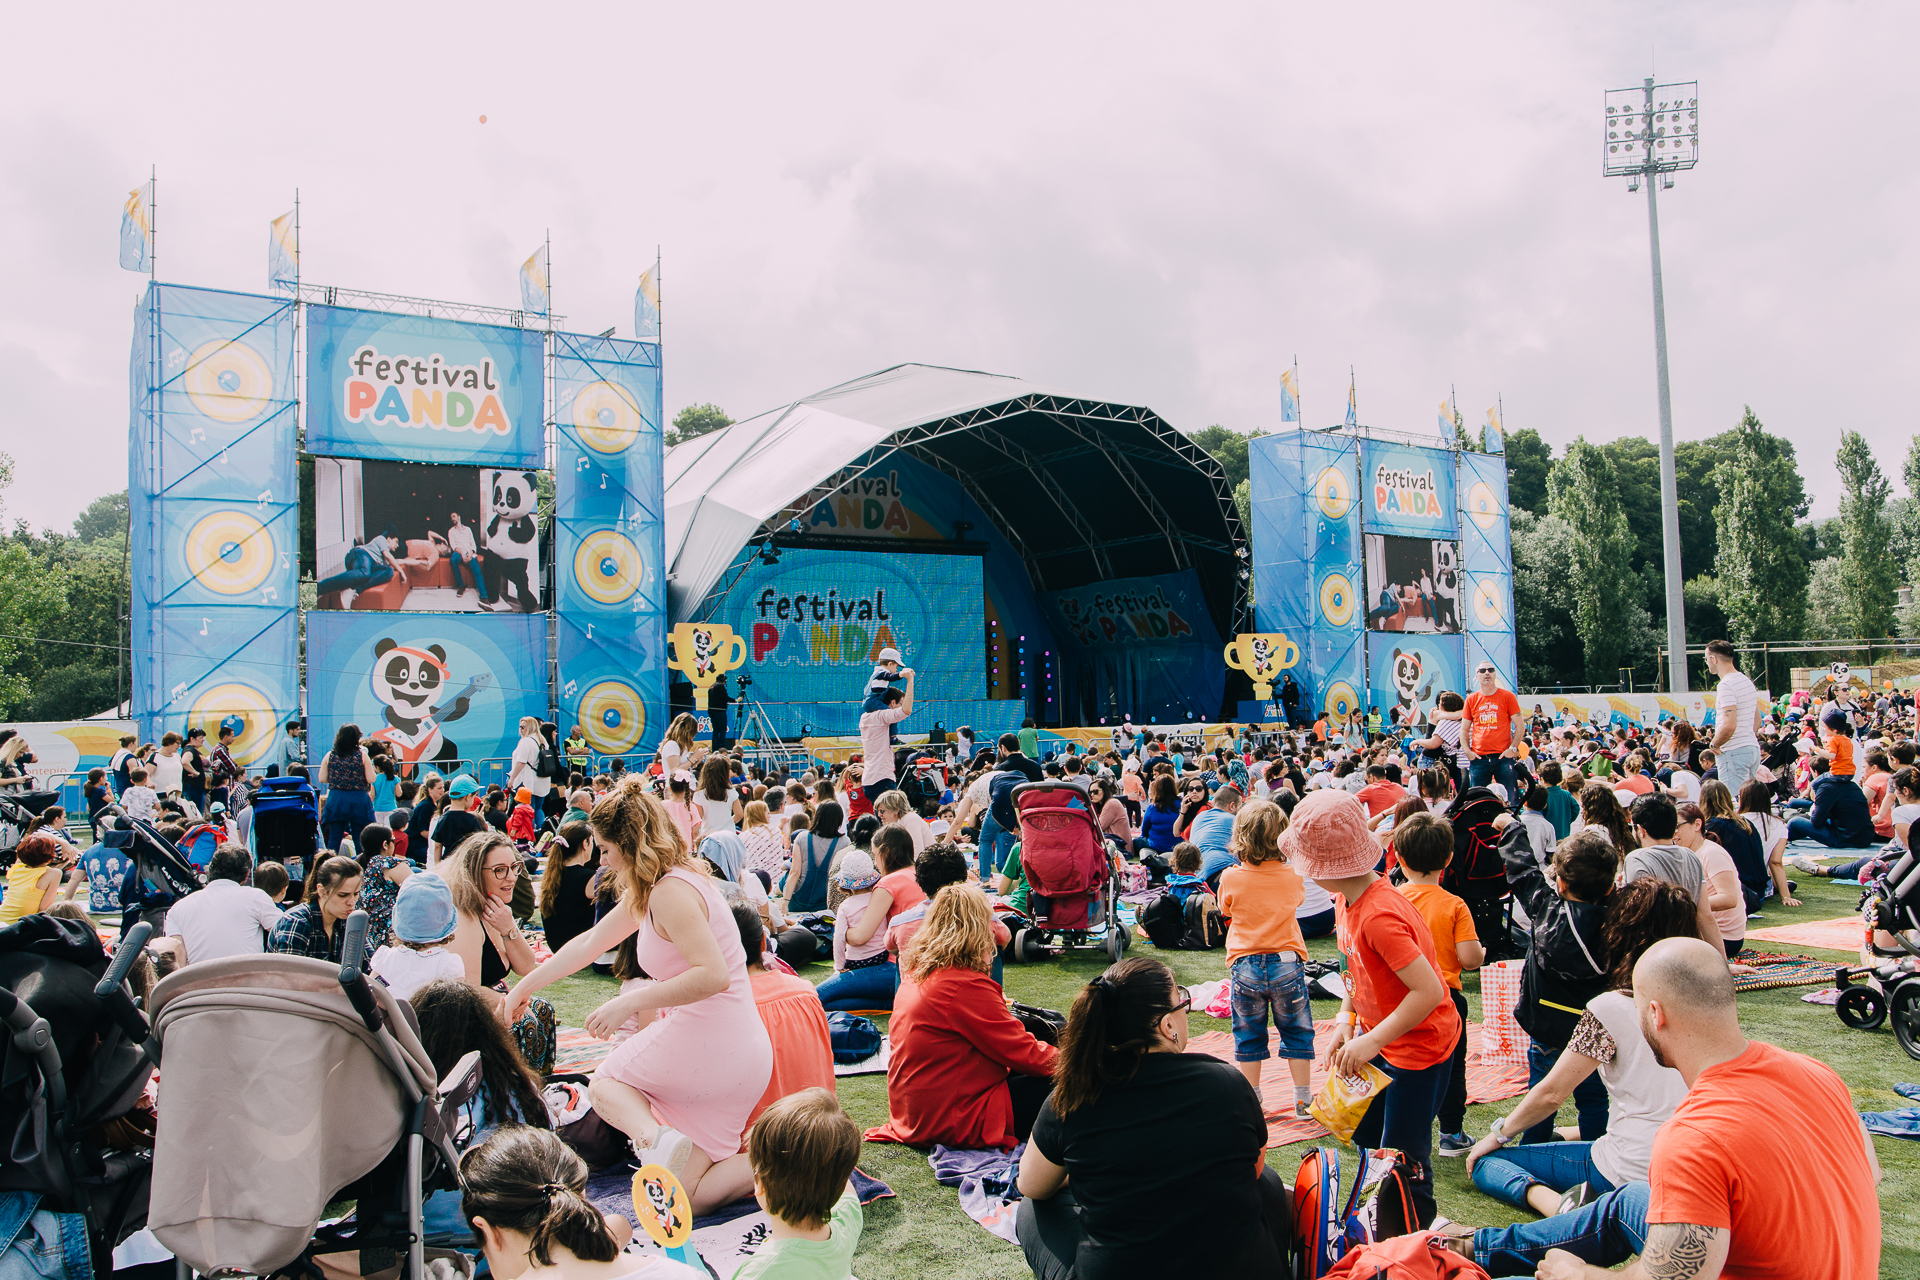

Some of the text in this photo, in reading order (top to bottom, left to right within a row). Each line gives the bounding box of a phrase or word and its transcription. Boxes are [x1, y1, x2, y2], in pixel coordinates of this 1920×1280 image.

[354, 350, 496, 390] festival
[349, 380, 508, 432] PANDA
[813, 470, 900, 497] stival
[1378, 466, 1434, 490] festival
[792, 494, 909, 532] PANDA
[1376, 486, 1441, 516] PANDA
[757, 589, 889, 623] festival
[1094, 586, 1171, 614] festival
[753, 622, 897, 662] PANDA
[1098, 610, 1192, 642] PANDA
[26, 766, 67, 776] ontepio
